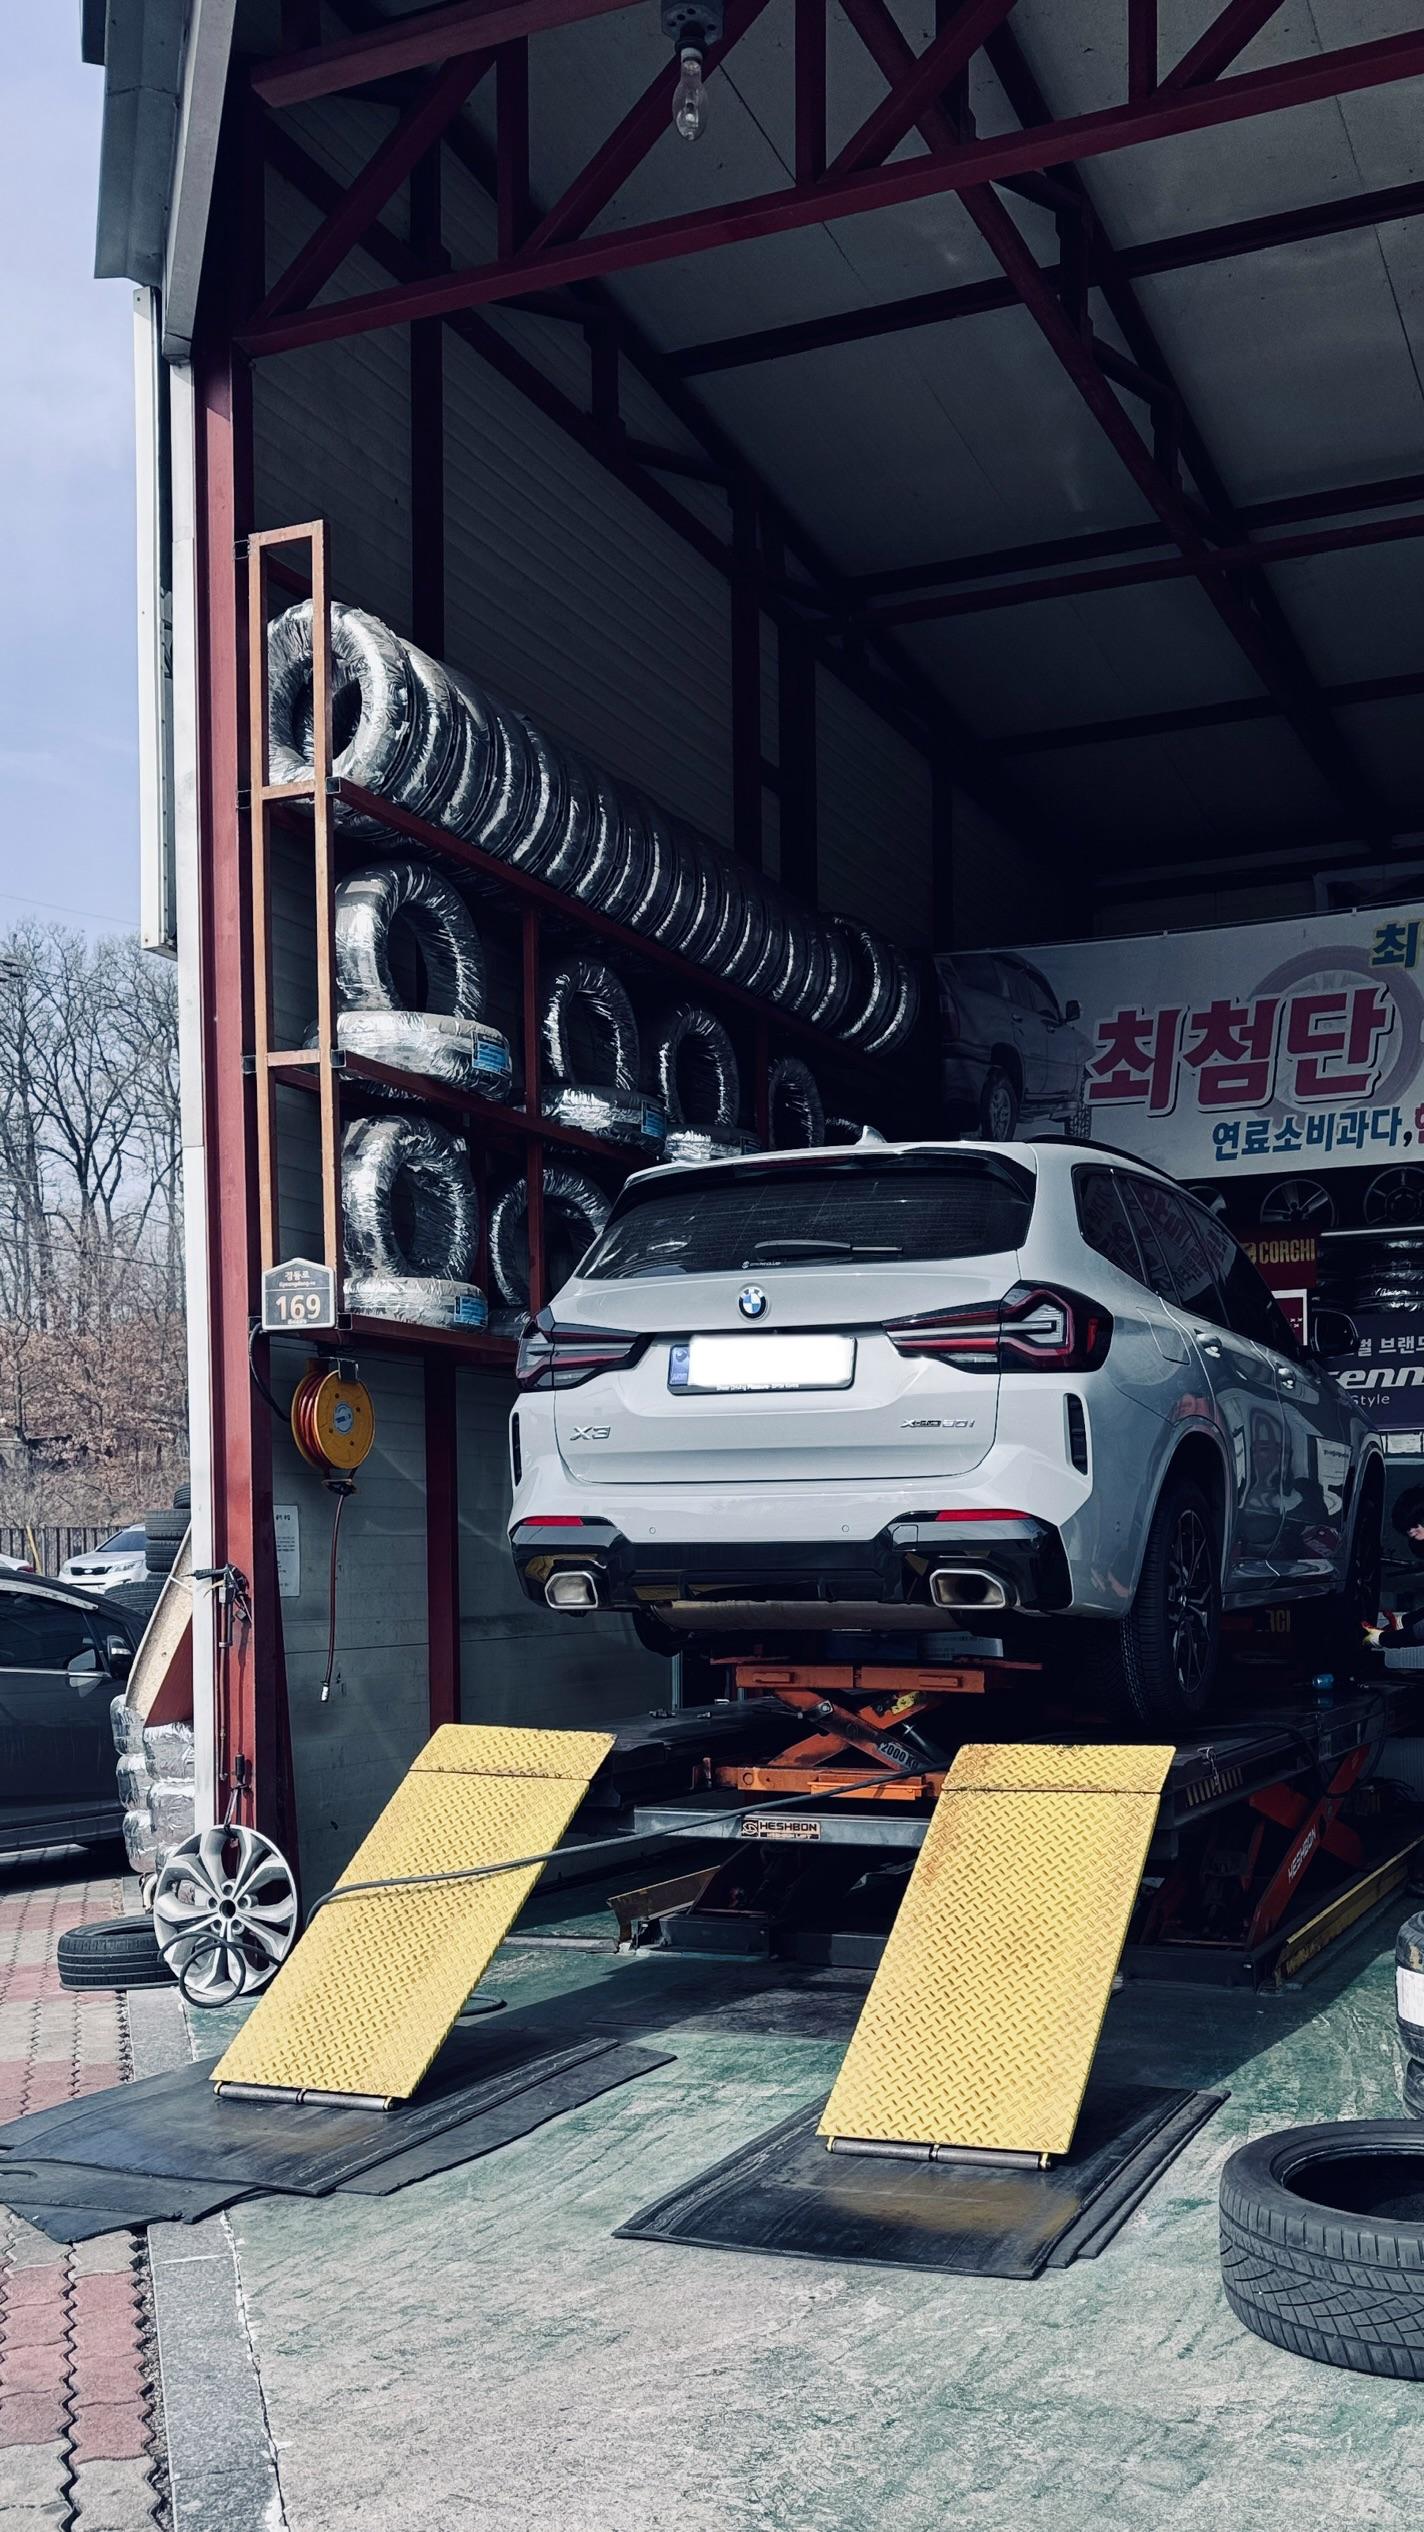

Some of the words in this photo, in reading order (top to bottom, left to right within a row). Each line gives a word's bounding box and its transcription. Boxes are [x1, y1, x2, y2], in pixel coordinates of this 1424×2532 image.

[1088, 988, 1387, 1110] 최첨단
[1259, 1238, 1315, 1264] CORGHI
[276, 1294, 320, 1320] 169
[569, 1425, 611, 1441] X3
[760, 1822, 817, 1832] HESHBON
[1287, 1824, 1317, 1884] HESHBON
